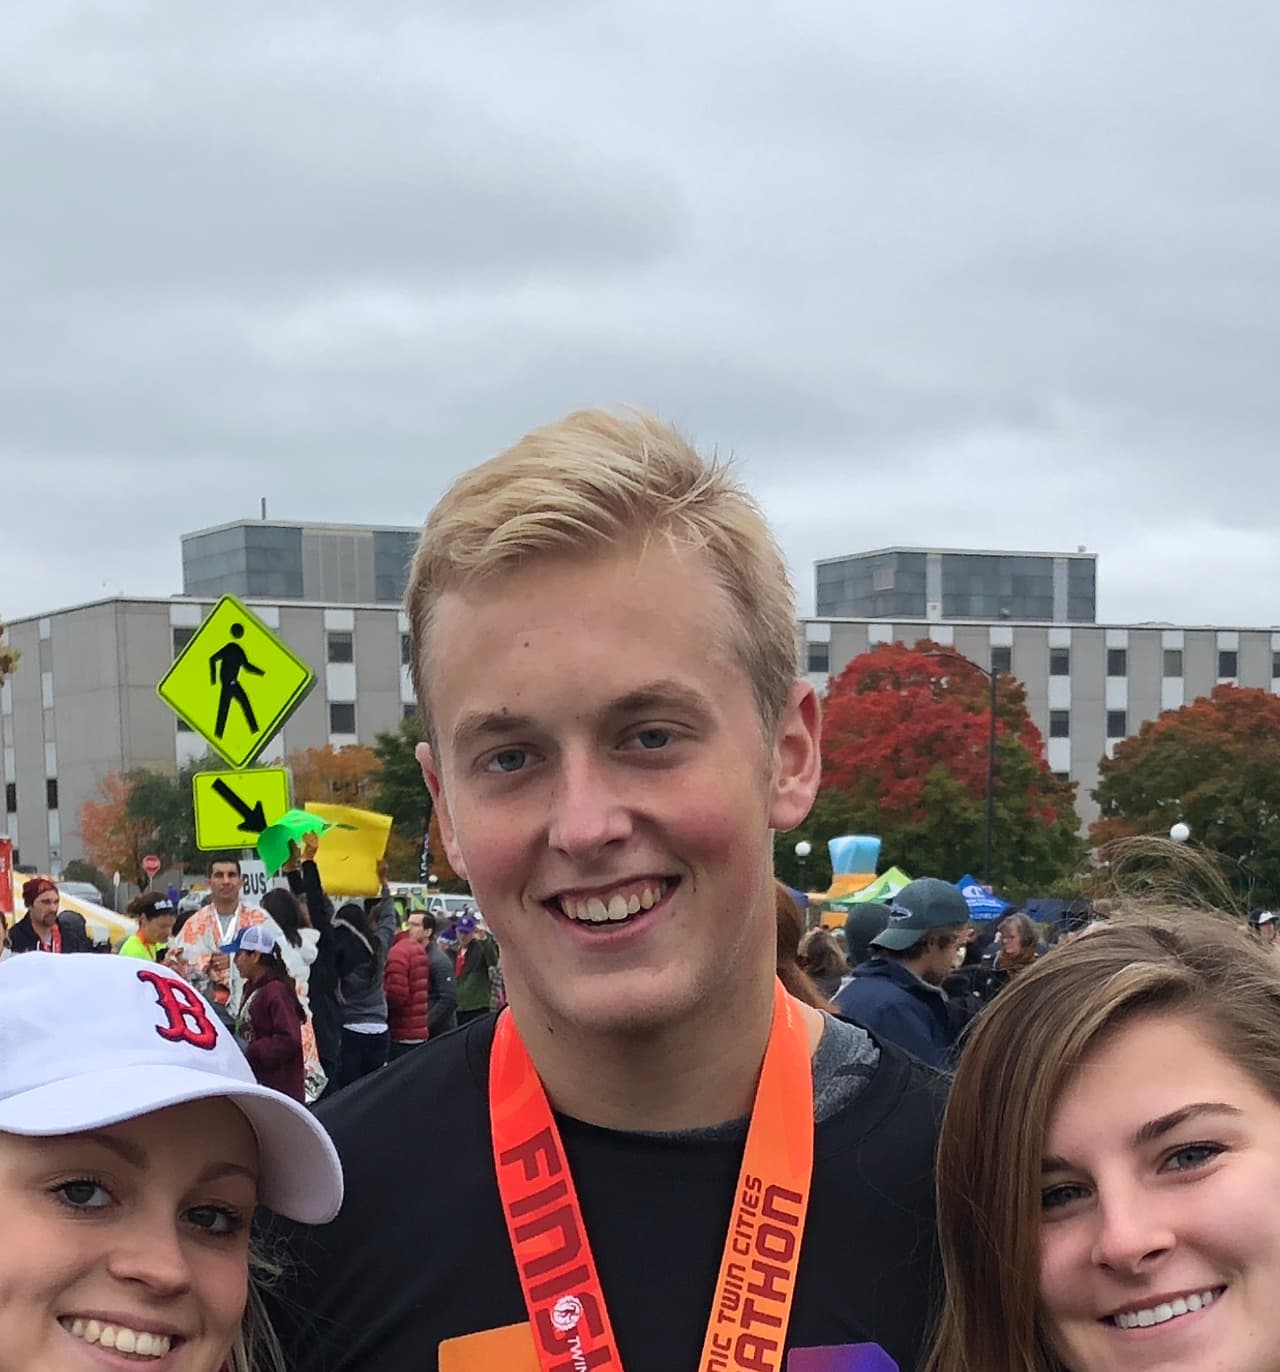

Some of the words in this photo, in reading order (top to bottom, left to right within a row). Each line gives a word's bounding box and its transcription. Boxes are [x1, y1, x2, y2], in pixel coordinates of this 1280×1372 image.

[242, 871, 267, 895] BUS
[137, 970, 218, 1051] B
[731, 1174, 763, 1257] CITIES
[717, 1262, 747, 1323] TWIN
